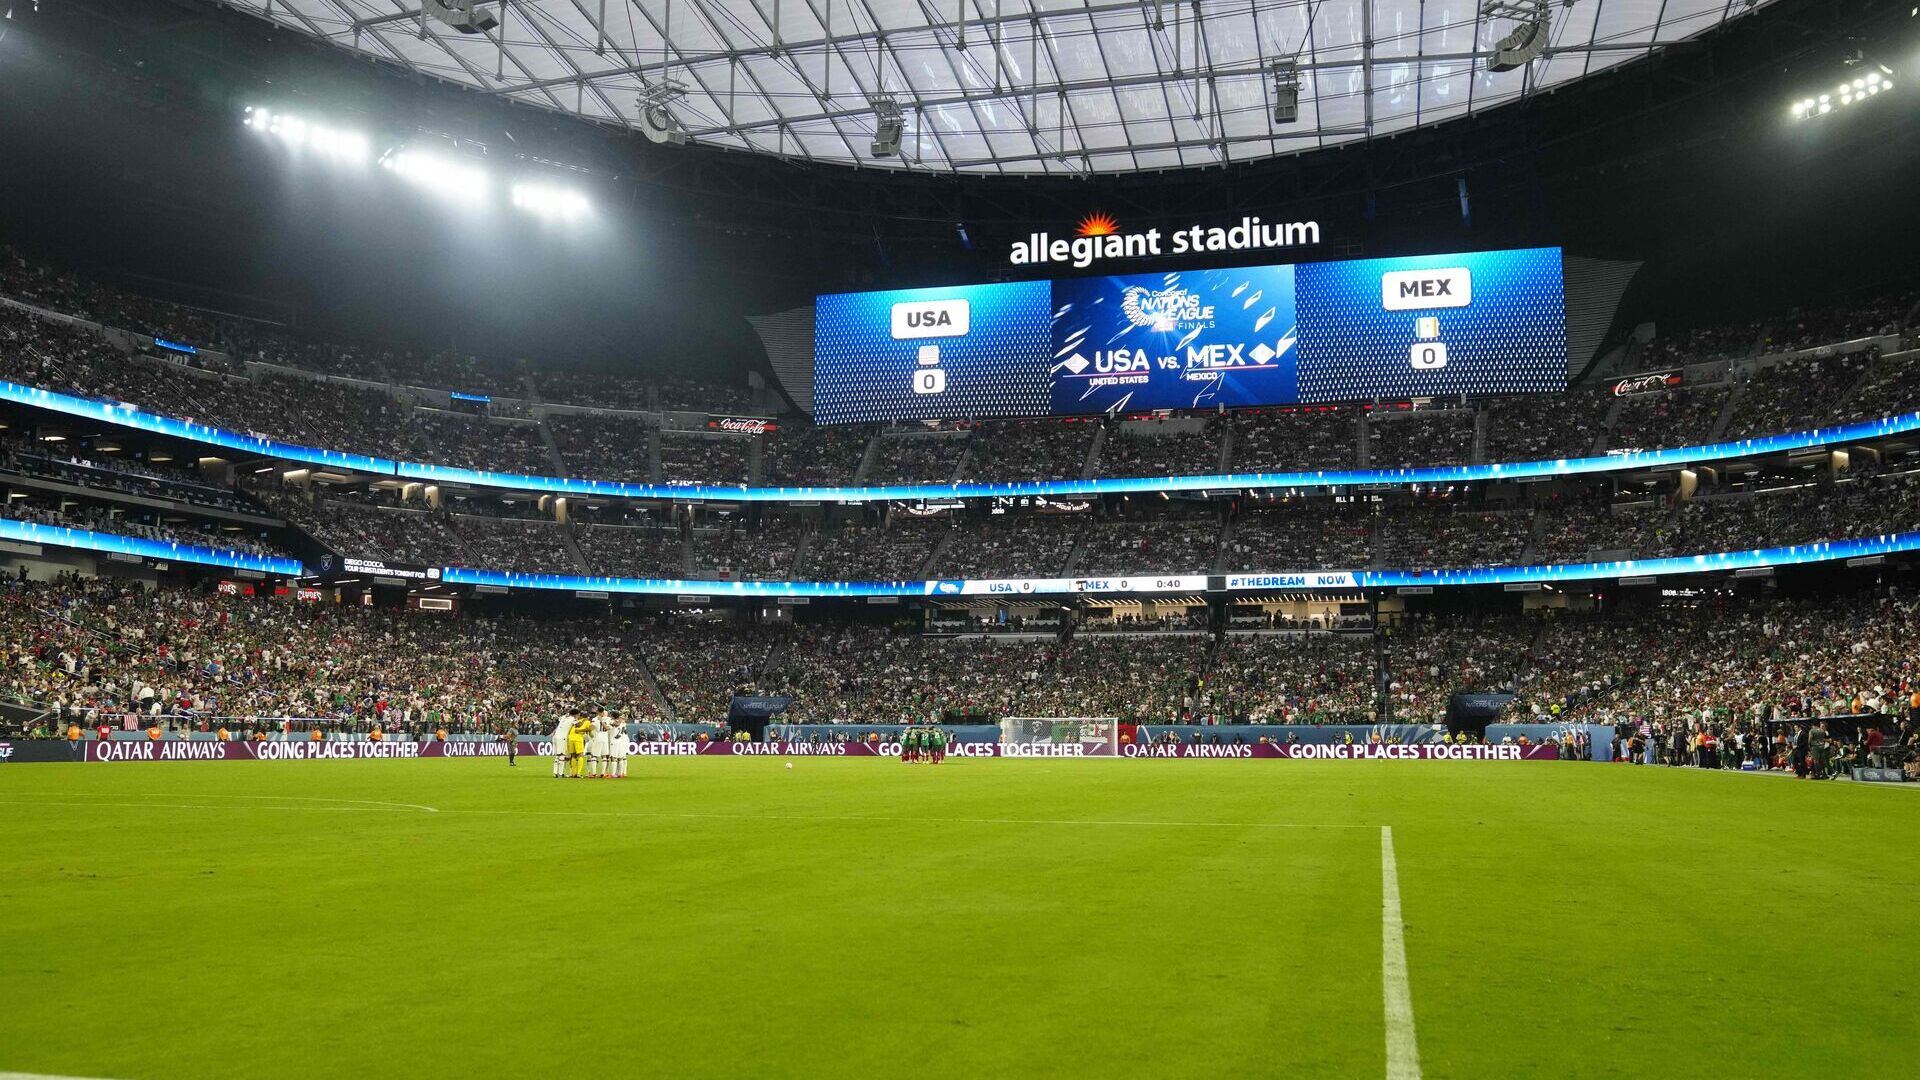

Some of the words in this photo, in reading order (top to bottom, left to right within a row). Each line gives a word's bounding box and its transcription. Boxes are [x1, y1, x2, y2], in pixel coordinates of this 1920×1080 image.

[1010, 228, 1161, 268] allegiant
[1172, 216, 1320, 254] stadium
[1399, 279, 1452, 298] MEX
[1141, 294, 1200, 311] NATIONS
[907, 310, 952, 328] USA
[1178, 321, 1216, 329] FINALS
[1095, 349, 1150, 373] USA
[1187, 343, 1246, 368] MEX
[1422, 348, 1436, 364] 0
[923, 374, 936, 390] 0
[1089, 376, 1118, 386] UNITED
[1119, 375, 1149, 384] STATES
[1186, 371, 1218, 381] MEXICO
[989, 583, 1013, 592] USA
[1023, 582, 1030, 590] 0
[1085, 581, 1109, 590] MEX
[1121, 580, 1128, 588] 0
[1156, 580, 1181, 588] 0:40
[1230, 577, 1305, 587] #THEDREAM
[1317, 575, 1346, 585] NOW
[97, 741, 154, 761] QATAR
[160, 741, 226, 760] AIRWAYS
[257, 741, 304, 760] GOING
[308, 741, 355, 759] PLACES
[357, 741, 419, 758] TOGETHER
[443, 741, 476, 757] QATAR
[478, 742, 519, 756] AIRWAS
[628, 742, 698, 756] OGETHER
[732, 742, 780, 756] QATAR
[784, 742, 846, 755] AIRWAYS
[945, 742, 993, 757] LACES
[997, 743, 1084, 757] TOGETHER
[1124, 743, 1178, 758] QATAR
[1183, 743, 1253, 758] AIRWAYS
[1289, 744, 1349, 759] GOING
[1352, 744, 1420, 759] PLACES
[1423, 744, 1522, 760] TOGETHER
